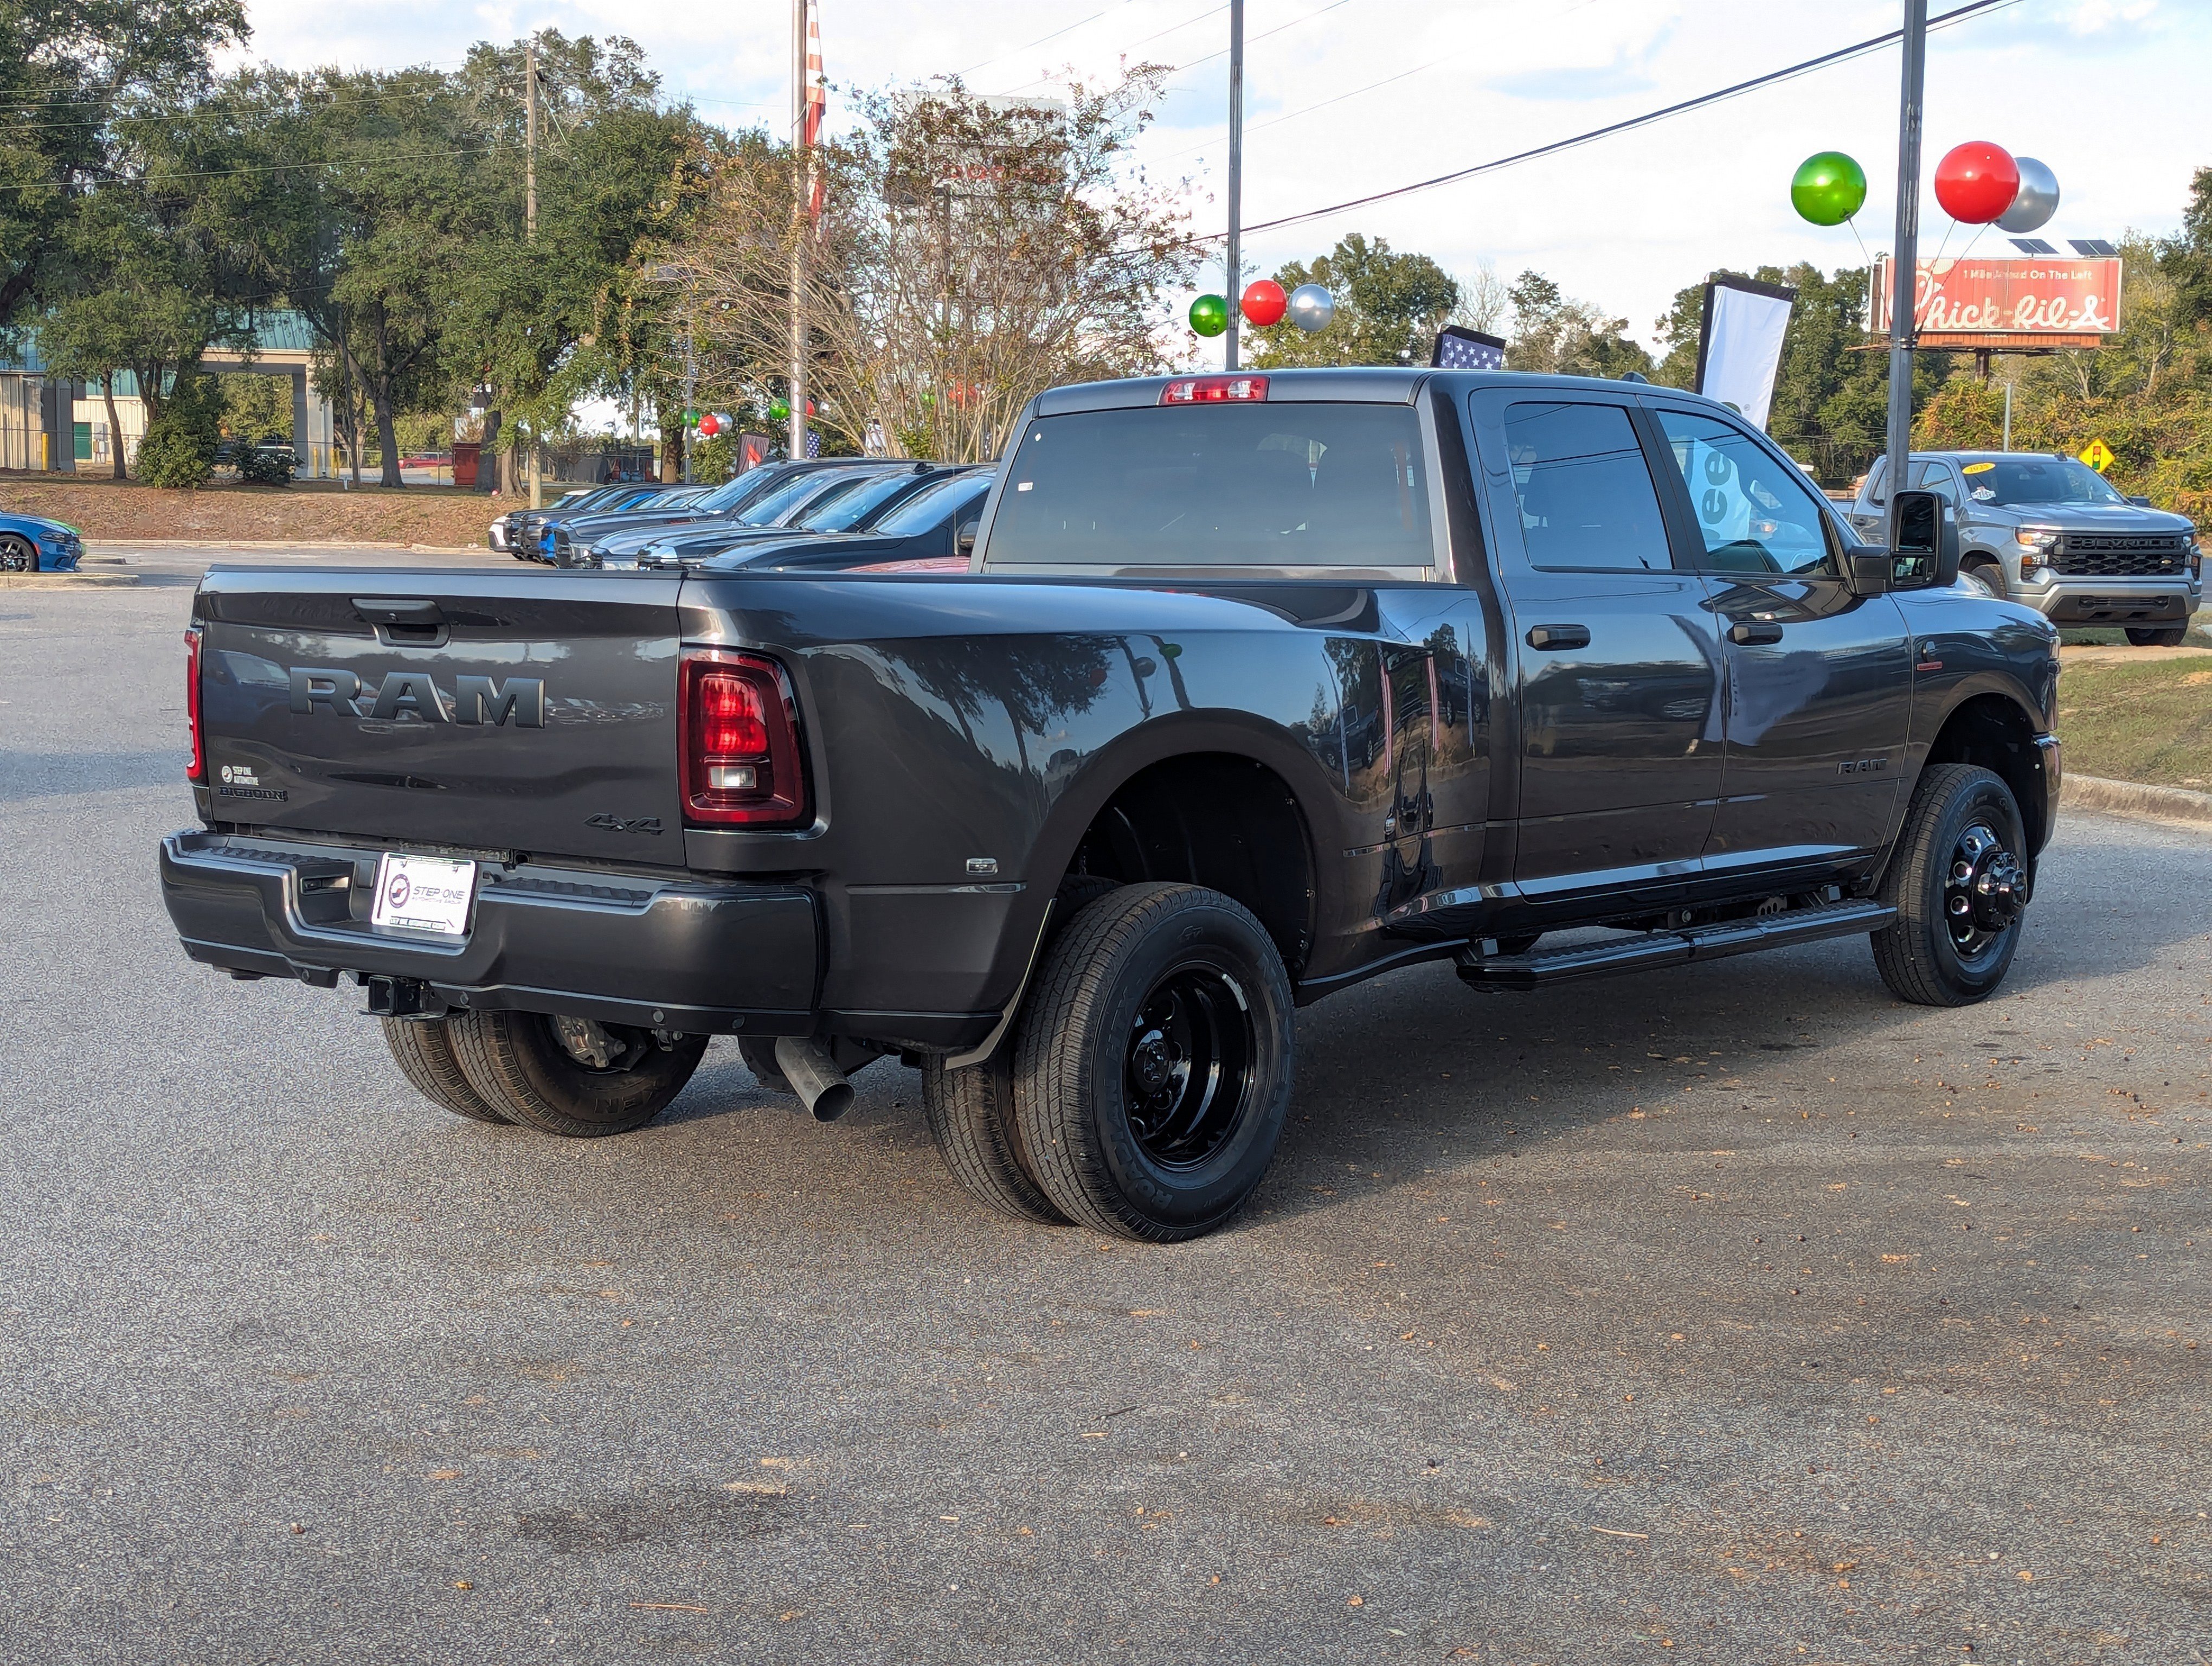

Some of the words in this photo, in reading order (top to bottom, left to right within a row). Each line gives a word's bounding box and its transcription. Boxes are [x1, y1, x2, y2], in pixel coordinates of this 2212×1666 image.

[2030, 270, 2046, 279] On
[2048, 270, 2068, 279] The
[290, 667, 545, 729] RAM
[1837, 758, 1887, 774] RAM
[413, 886, 440, 896] STEP
[442, 889, 465, 900] ONE
[1102, 1077, 1173, 1210] ROADIAN
